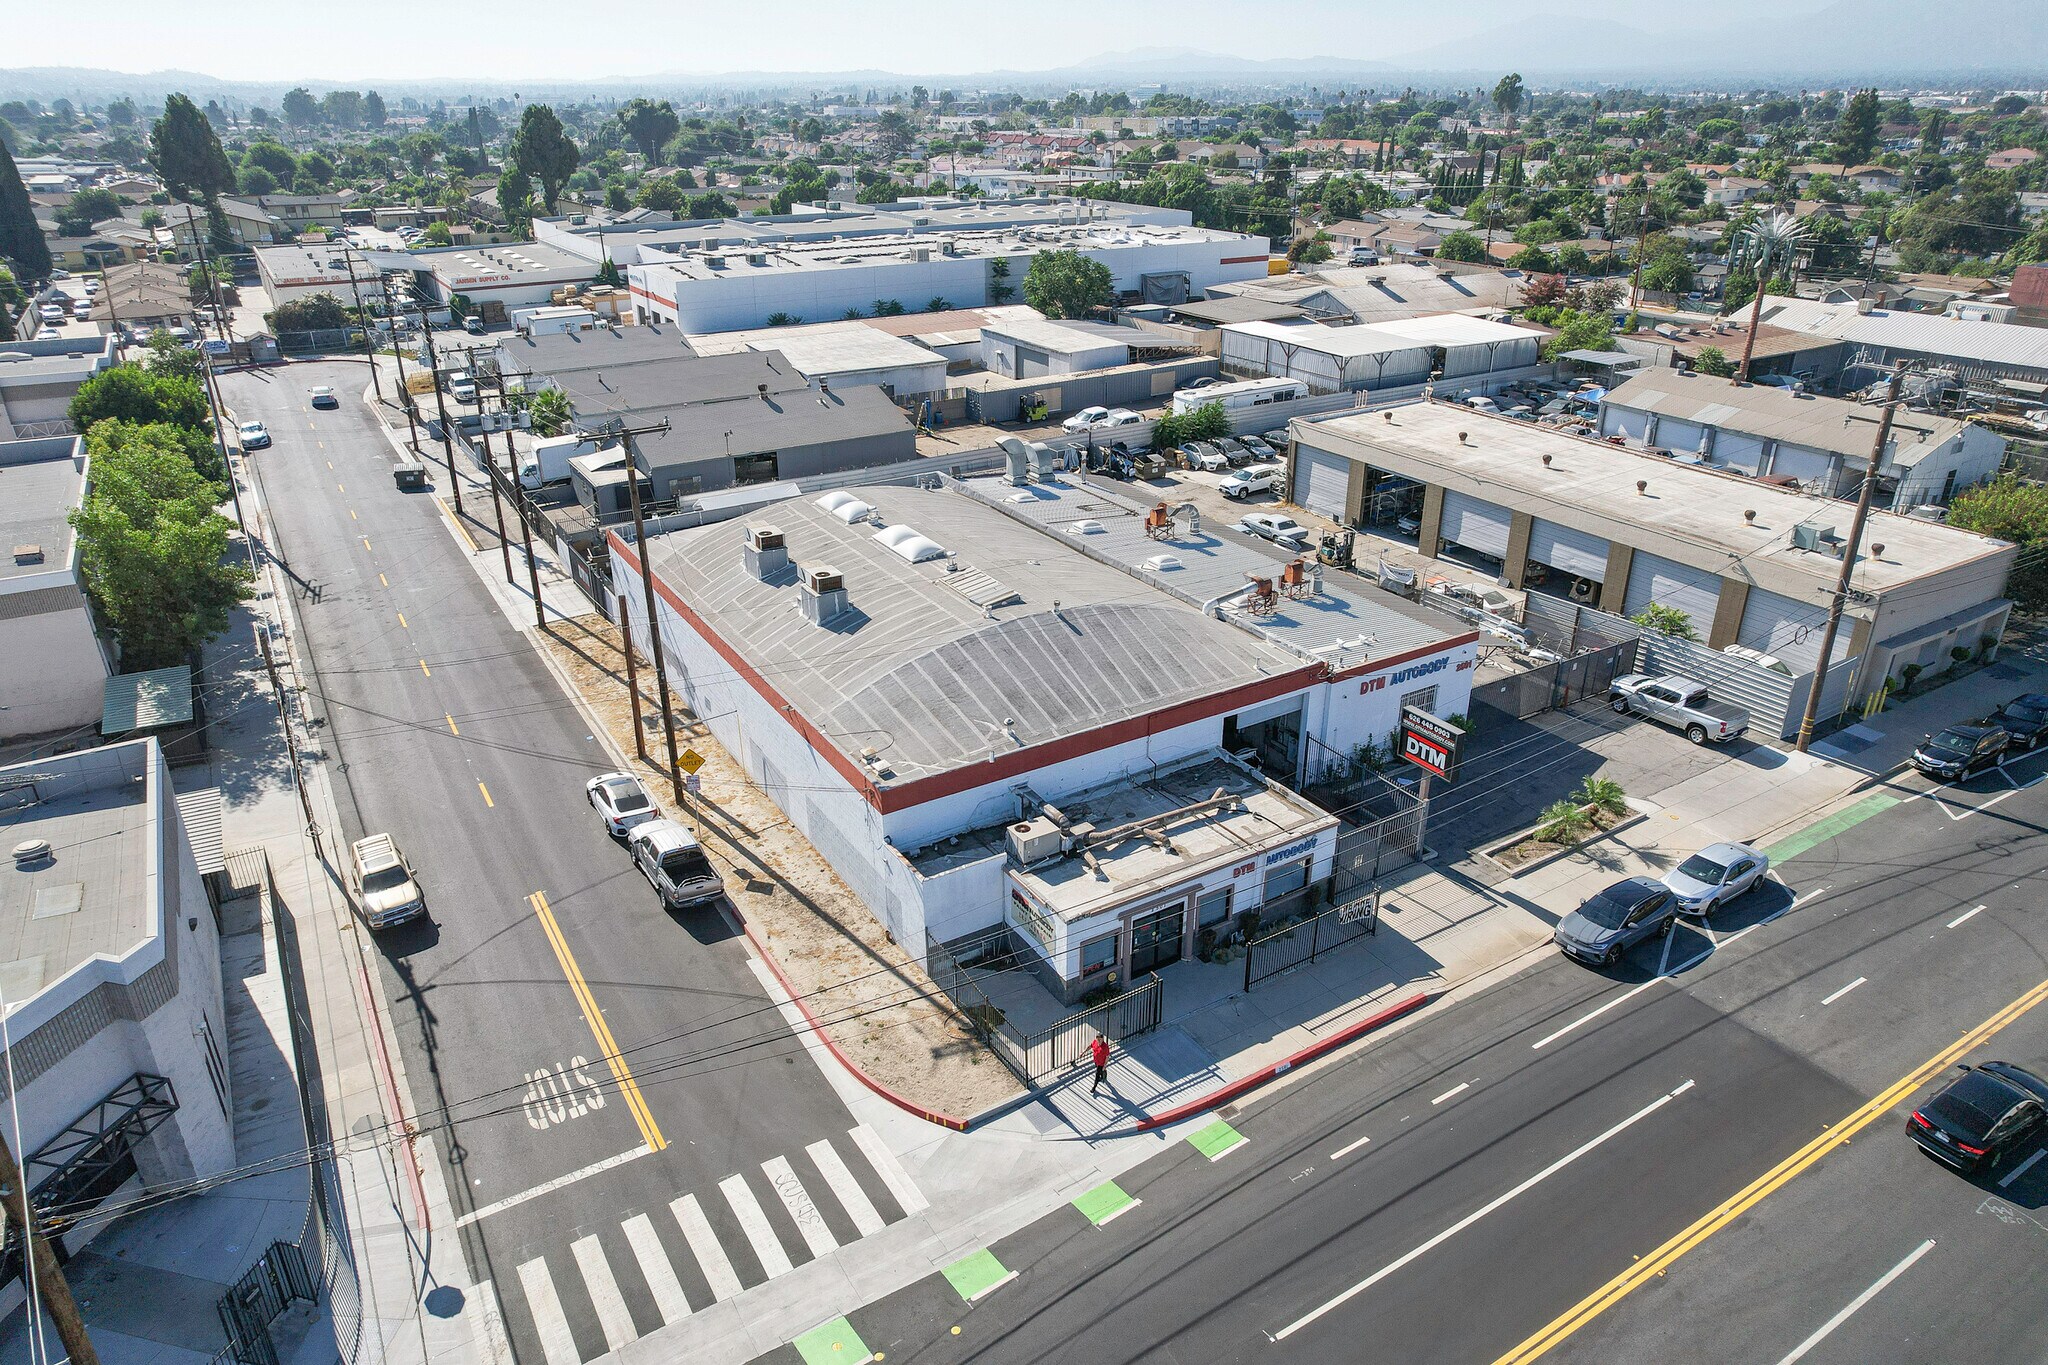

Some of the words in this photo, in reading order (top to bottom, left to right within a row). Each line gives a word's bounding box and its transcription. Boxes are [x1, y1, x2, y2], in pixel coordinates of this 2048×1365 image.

[307, 275, 328, 283] SUPPLY
[455, 277, 477, 285] JANSEN
[1360, 676, 1386, 695] DTM
[1390, 657, 1450, 685] AUTOBODY
[1408, 713, 1421, 724] 626
[1421, 719, 1434, 730] 448
[1434, 726, 1451, 739] 0903
[1406, 736, 1447, 770] DTM
[1233, 861, 1256, 879] DTM
[1266, 835, 1318, 866] AUTOBODY
[522, 1055, 606, 1130] STOP
